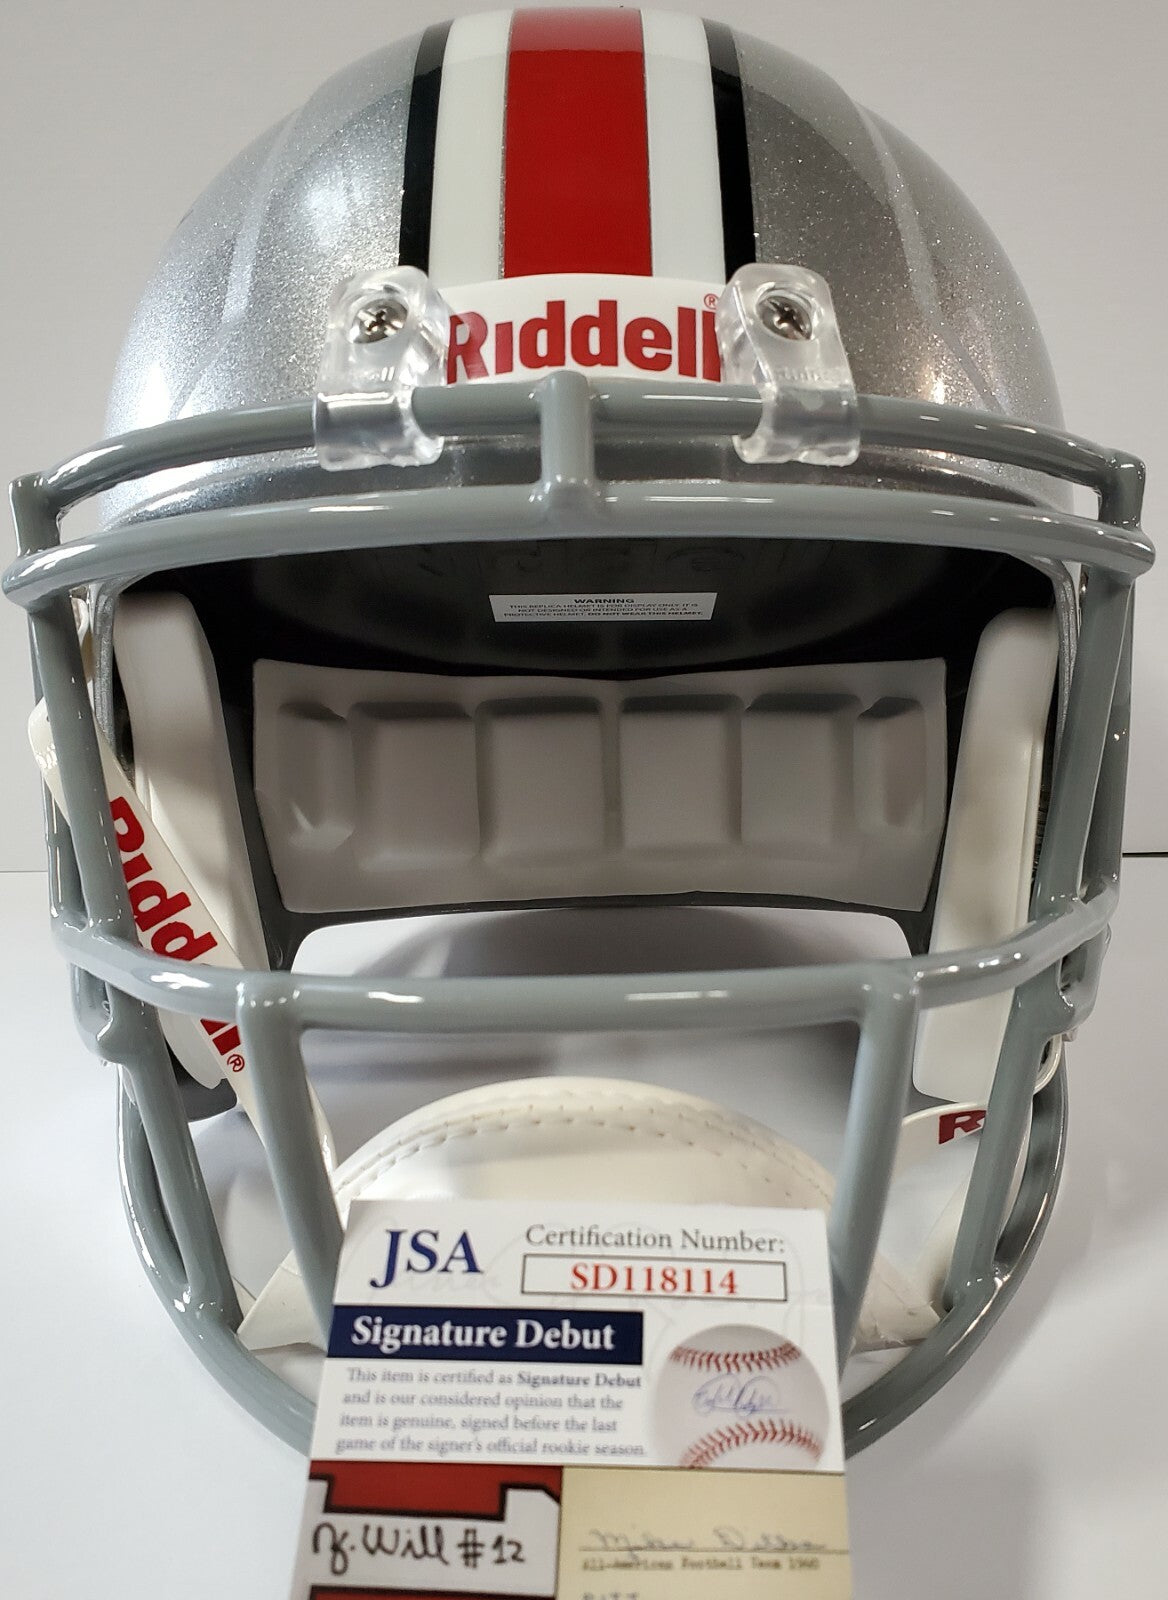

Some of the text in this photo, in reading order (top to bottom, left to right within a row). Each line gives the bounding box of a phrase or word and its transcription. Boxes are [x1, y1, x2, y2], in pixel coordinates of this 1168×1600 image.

[446, 299, 721, 385] Riddell
[526, 1224, 786, 1254] Certification Number:
[370, 1228, 484, 1288] JSA
[570, 1262, 737, 1295] SD118114
[351, 1315, 616, 1355] Signature Debut
[347, 1367, 642, 1388] This item is certified as Signature Debut
[343, 1389, 624, 1410] and is our considered opinion that the
[339, 1412, 618, 1432] item is genuine, signed before the last
[334, 1438, 376, 1455] game
[380, 1434, 396, 1451] of
[400, 1435, 424, 1451] the
[427, 1436, 482, 1457] signer's
[486, 1437, 538, 1453] official
[542, 1439, 590, 1455] rookie
